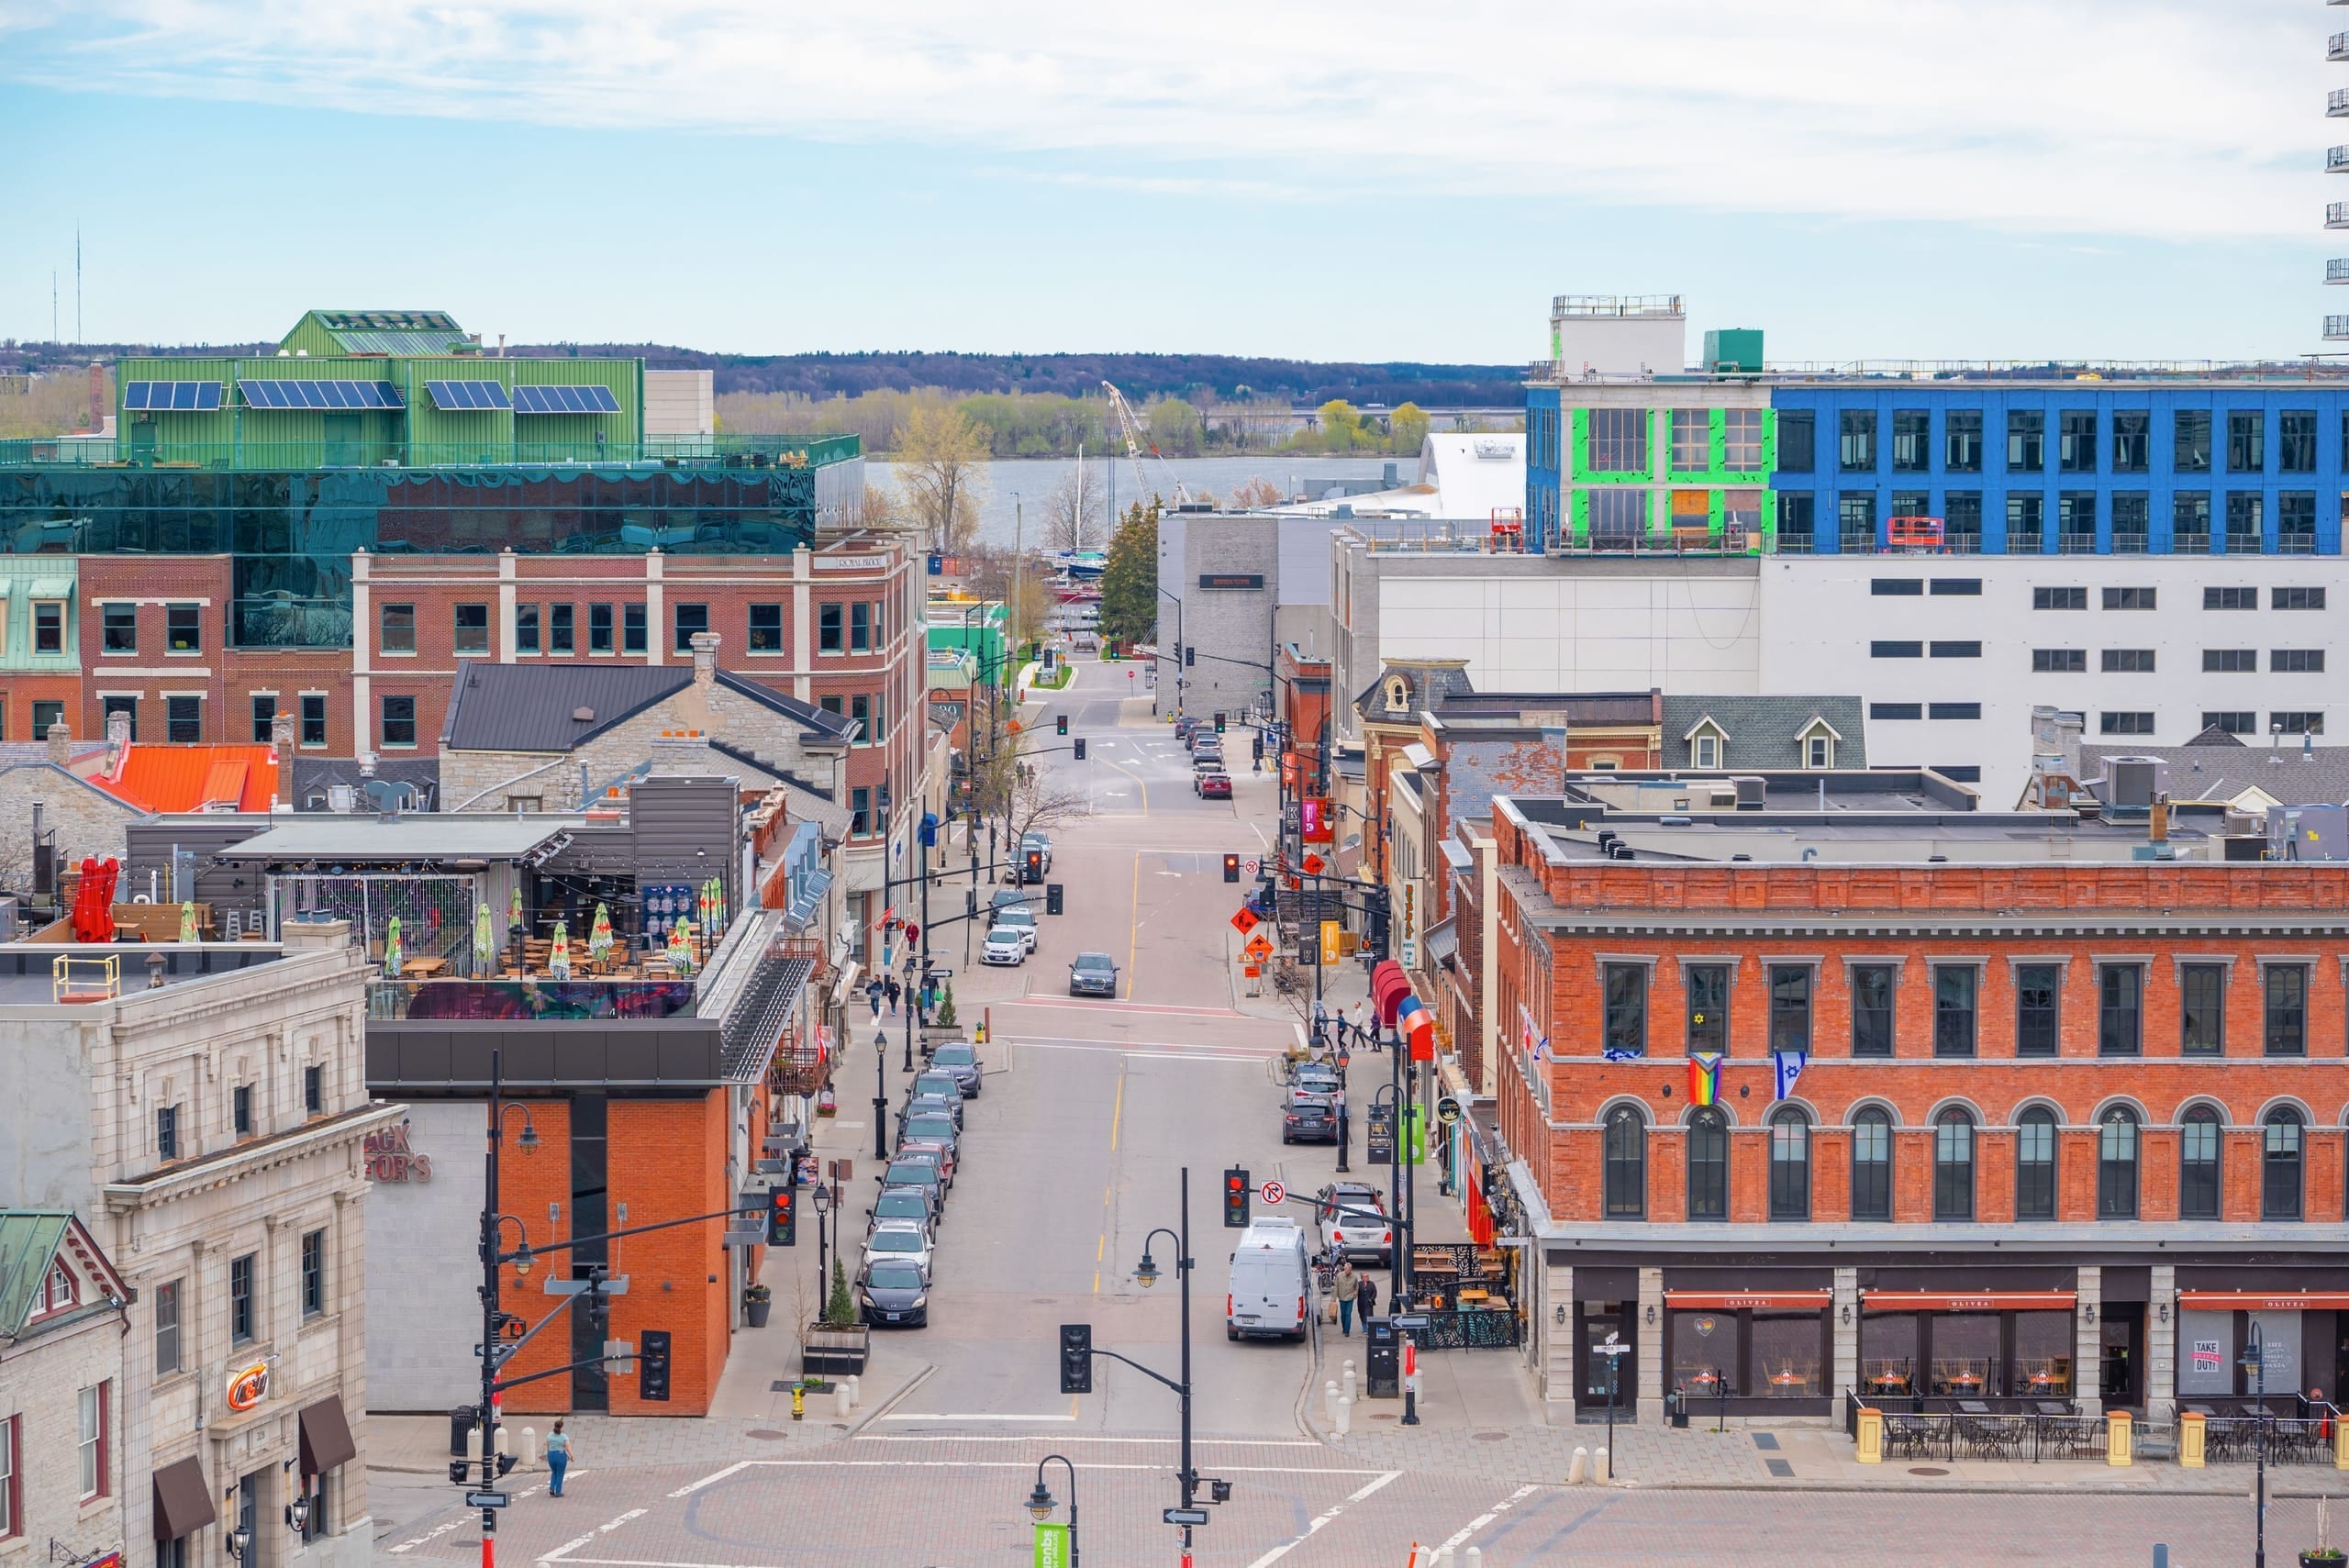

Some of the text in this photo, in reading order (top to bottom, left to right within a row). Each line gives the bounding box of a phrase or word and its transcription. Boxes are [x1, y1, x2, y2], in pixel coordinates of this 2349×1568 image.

[363, 1123, 413, 1152] ACK
[2196, 1342, 2217, 1353] TAKE
[2196, 1360, 2216, 1371] OUT!
[234, 1374, 268, 1406] A&W
